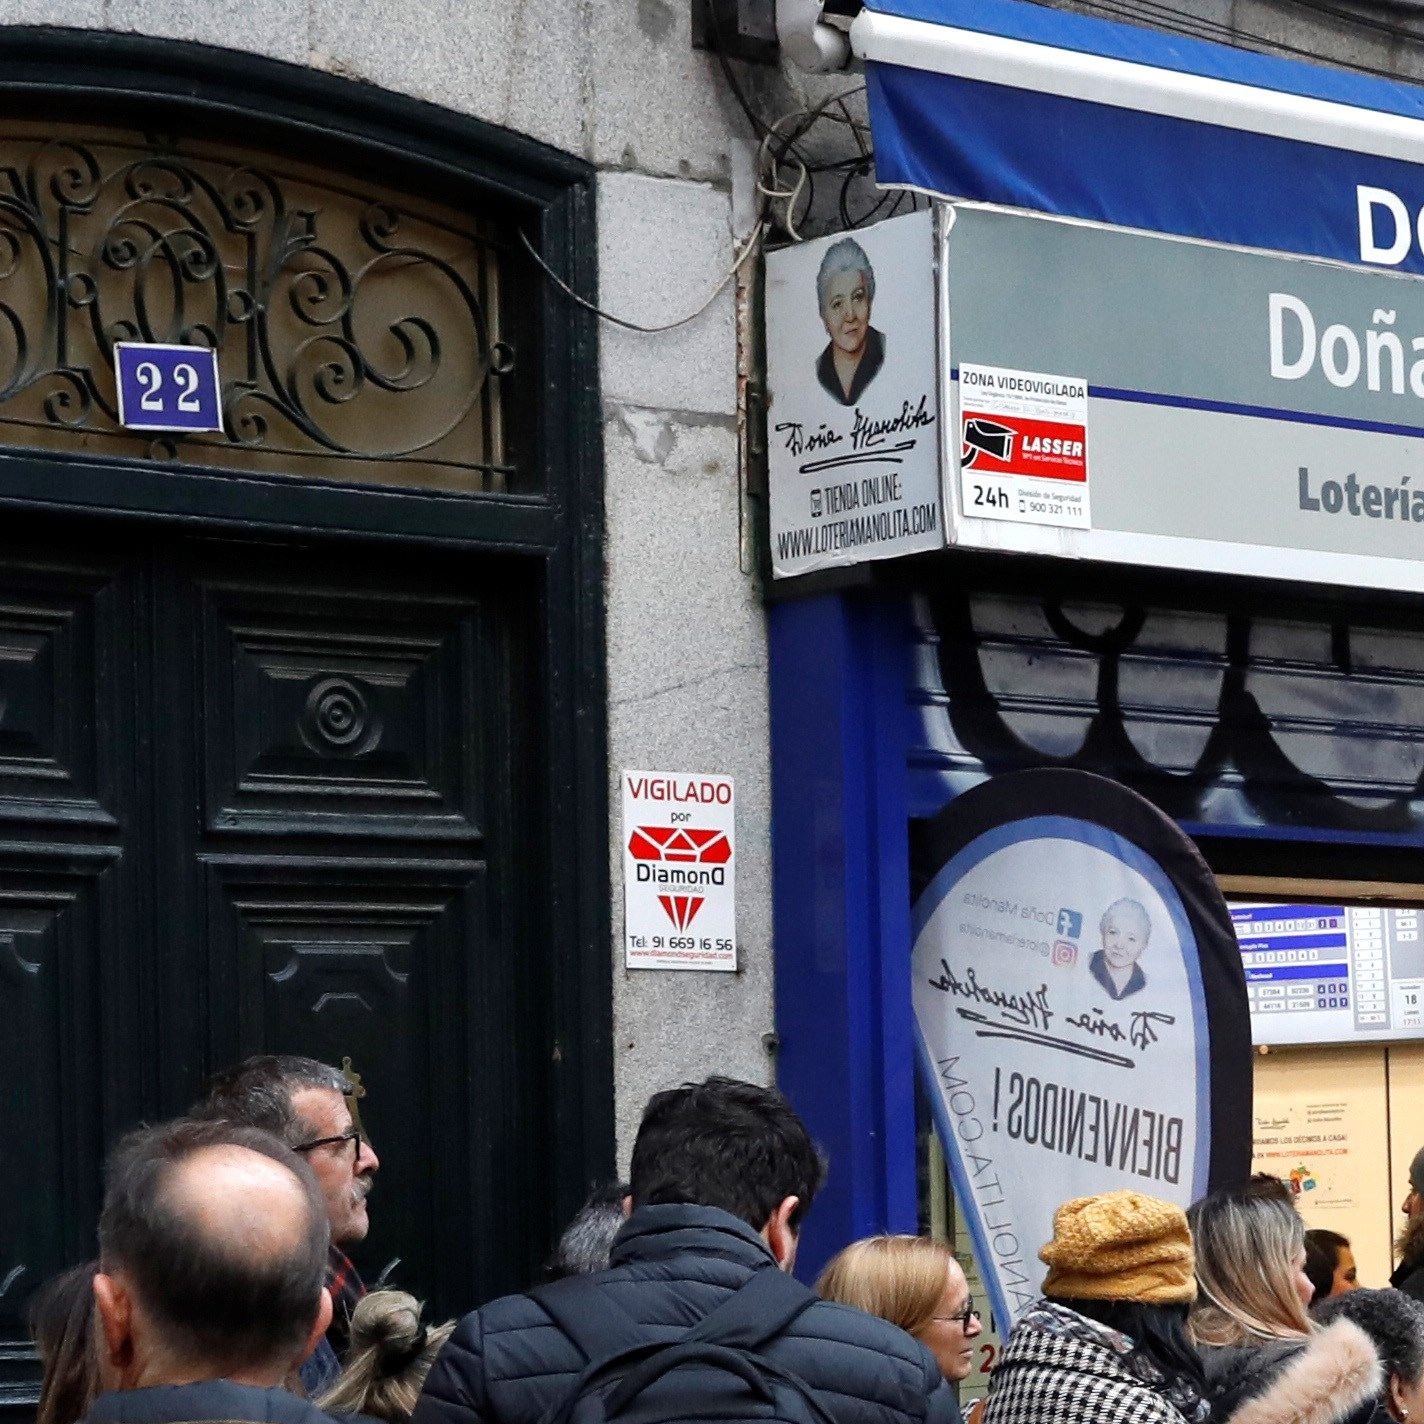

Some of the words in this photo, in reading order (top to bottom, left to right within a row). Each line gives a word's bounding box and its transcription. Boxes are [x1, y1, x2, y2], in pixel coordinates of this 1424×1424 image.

[136, 362, 200, 412] 22
[963, 371, 995, 387] ZONA
[998, 376, 1085, 399] VIDEOVIGILADA
[1022, 436, 1083, 457] LASSER
[824, 485, 860, 516] TIENDA
[974, 485, 1009, 508] 24h
[1029, 501, 1046, 513] 900
[1049, 504, 1063, 514] 321
[1067, 506, 1082, 516] 111
[777, 503, 936, 560] WWW.LOTERIAMANOLITA.COM
[628, 777, 732, 804] VIGILADO
[671, 812, 691, 823] por
[653, 936, 664, 948] 91
[669, 937, 695, 949] 669
[700, 938, 711, 950] 16
[716, 939, 733, 951] 56
